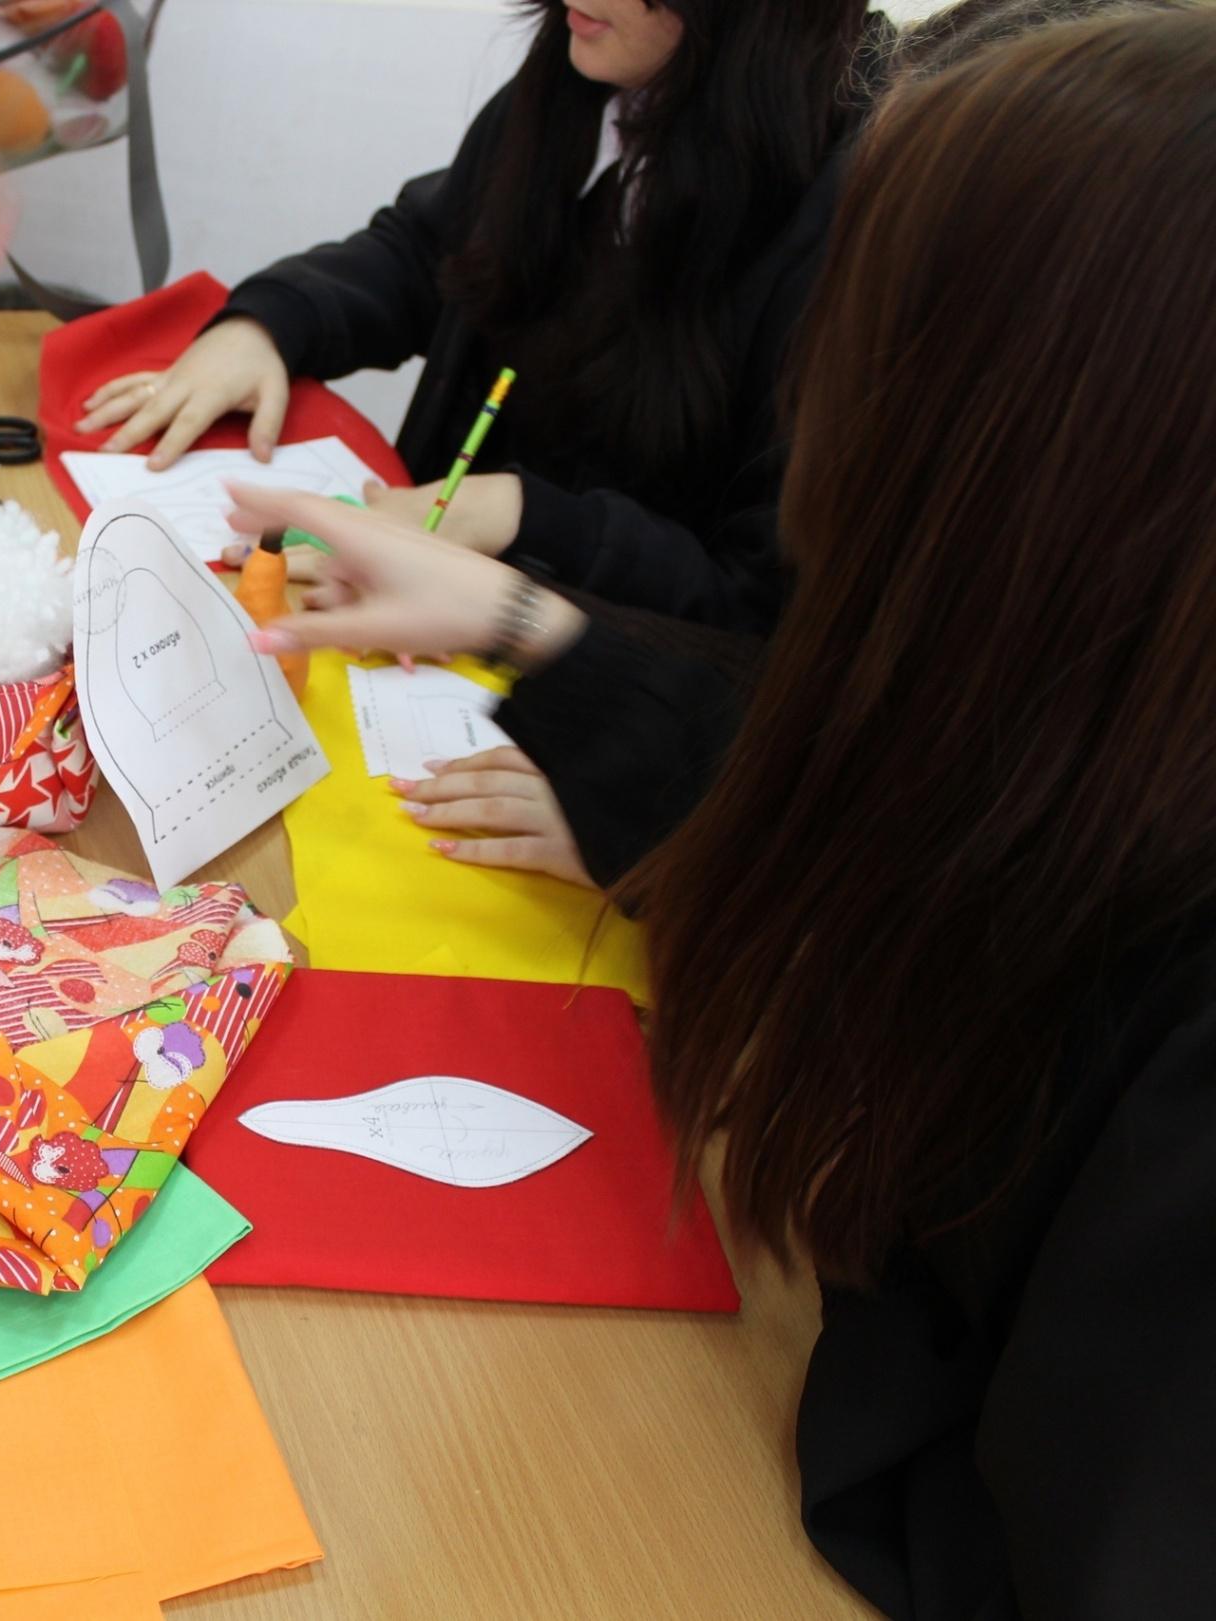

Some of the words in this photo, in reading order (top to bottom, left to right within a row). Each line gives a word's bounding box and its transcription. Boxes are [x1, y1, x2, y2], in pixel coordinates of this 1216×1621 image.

[148, 629, 181, 657] яблоко
[132, 655, 142, 669] 2
[256, 765, 287, 793] яблоко
